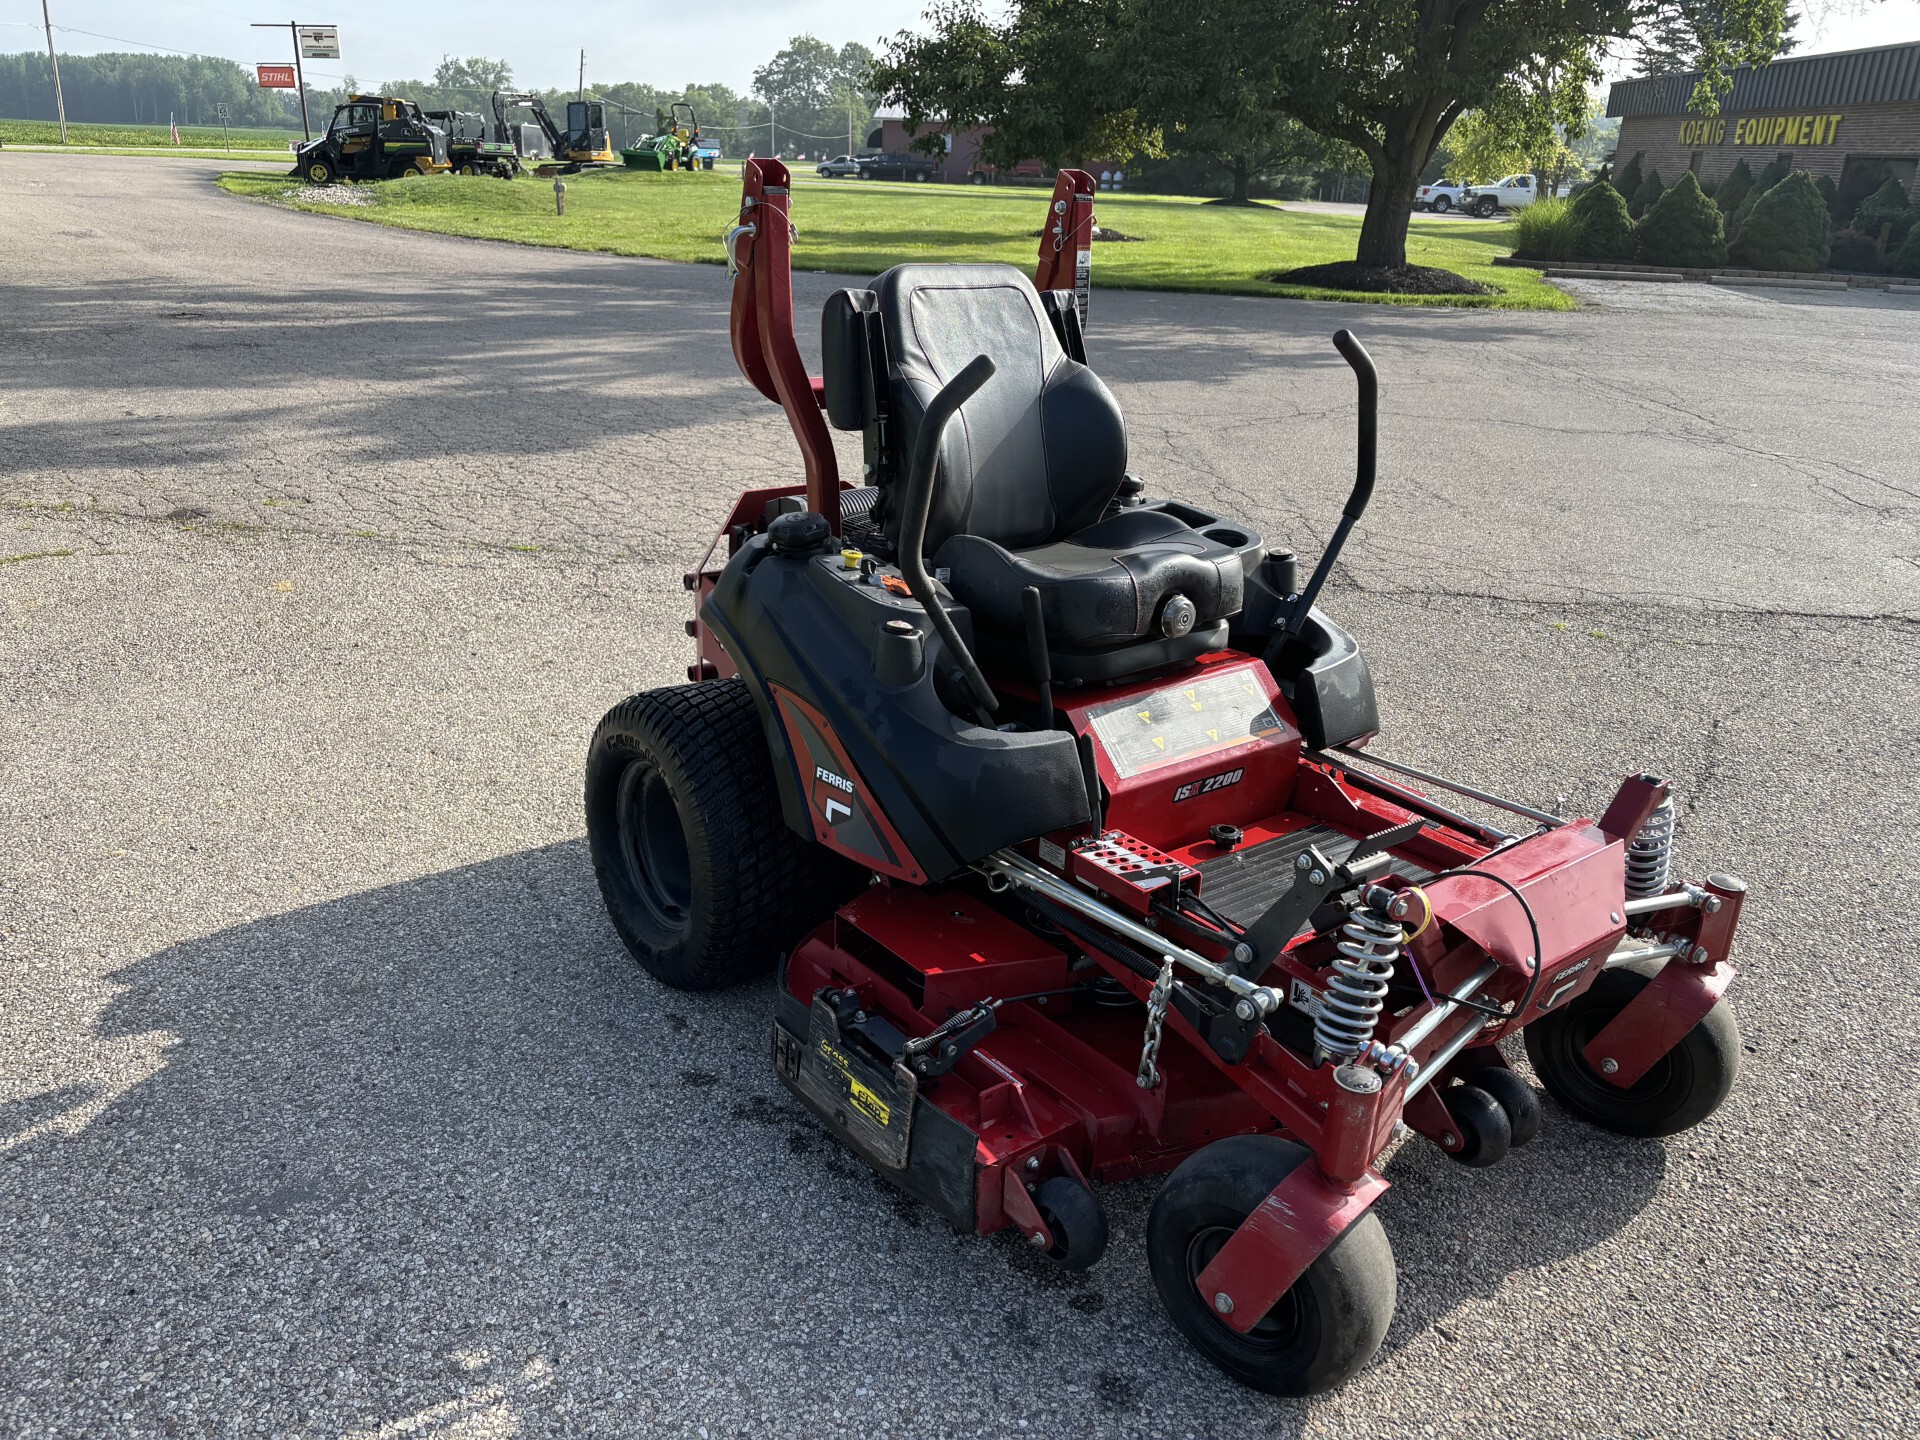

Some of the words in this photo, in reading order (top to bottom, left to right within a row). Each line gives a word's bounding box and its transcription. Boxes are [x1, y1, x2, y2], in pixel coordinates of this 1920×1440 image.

[261, 72, 291, 82] STIHL
[219, 109, 228, 118] 50
[1678, 119, 1726, 145] KOENIG
[1734, 115, 1842, 145] EQUIPMENT
[816, 766, 853, 793] FERRIS
[1202, 768, 1243, 793] 2200
[1552, 957, 1591, 984] FERRIS
